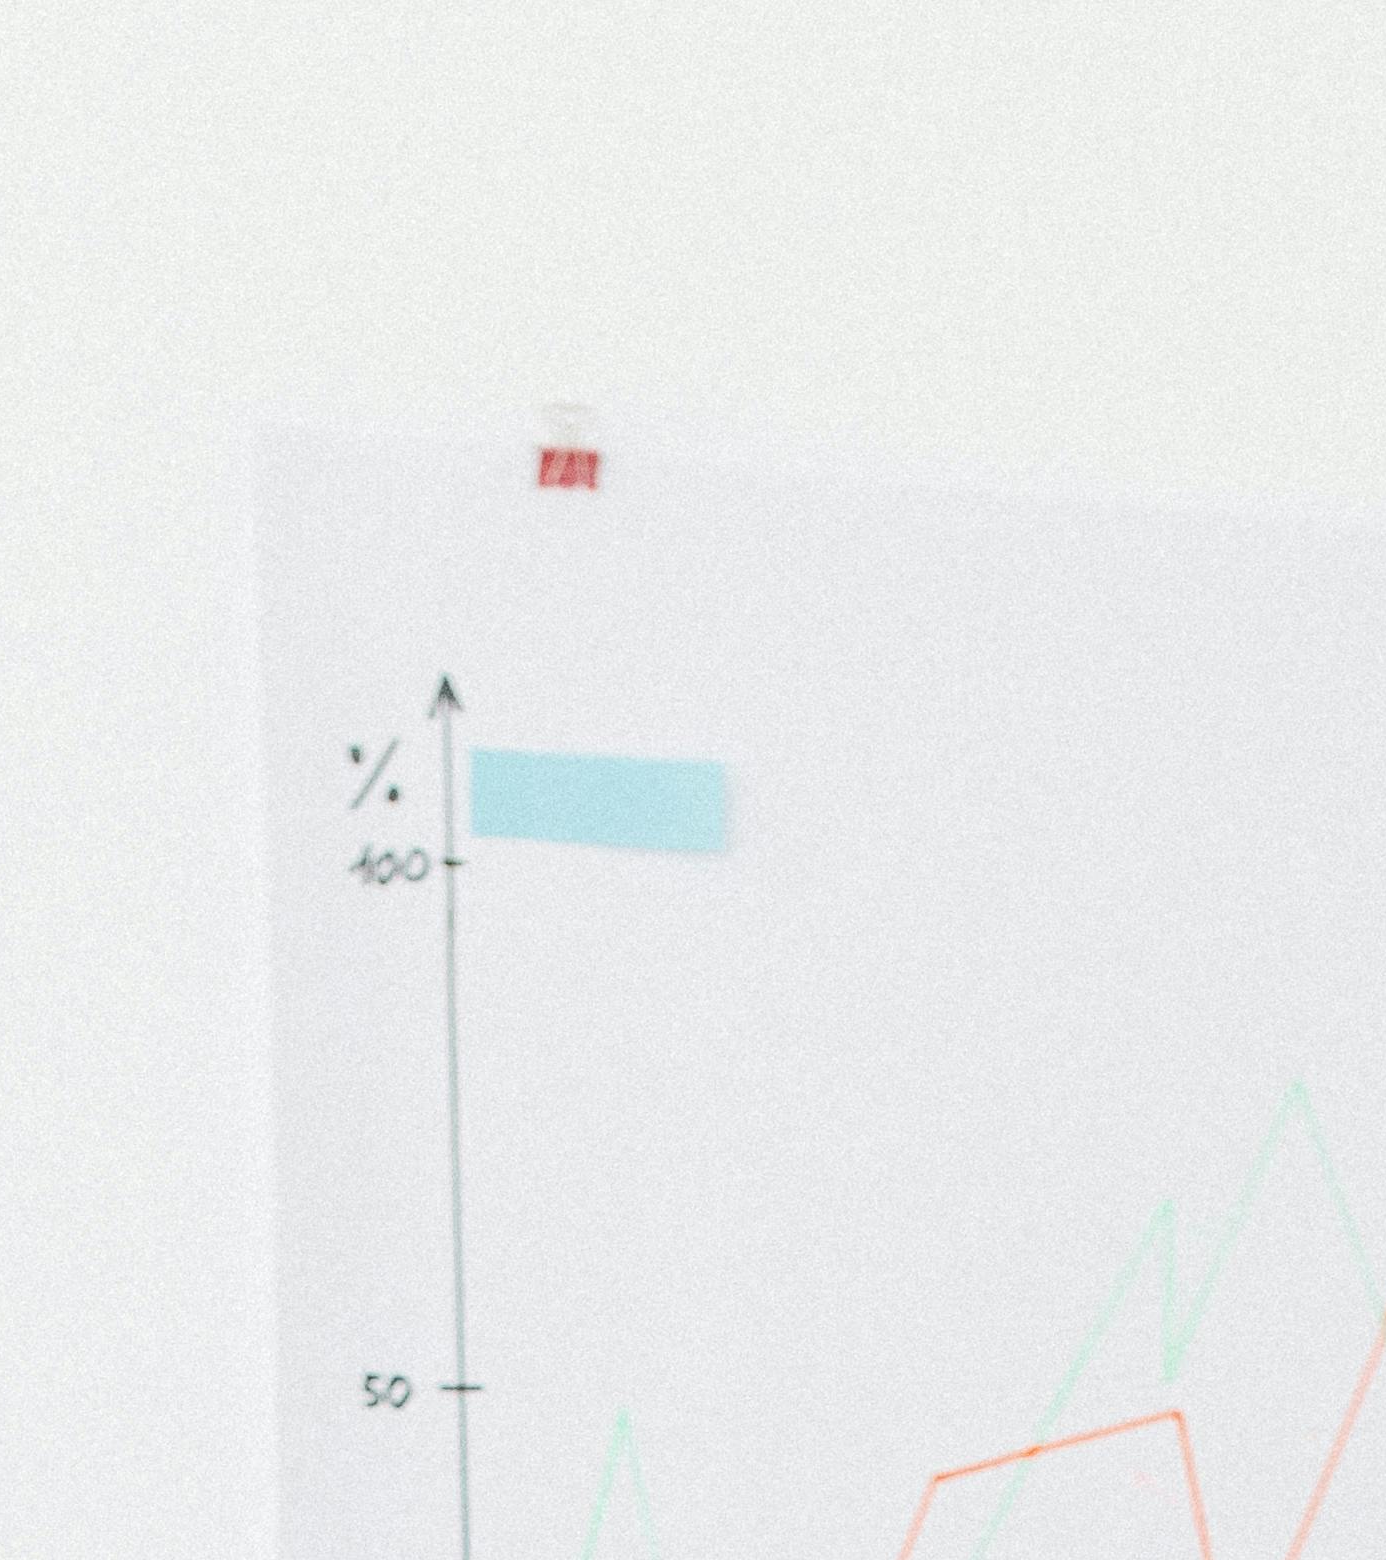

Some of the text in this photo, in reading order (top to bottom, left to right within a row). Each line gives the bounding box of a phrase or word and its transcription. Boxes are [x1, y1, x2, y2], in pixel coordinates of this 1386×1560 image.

[349, 737, 399, 809] %
[349, 843, 431, 886] 100
[363, 1374, 411, 1408] 50
